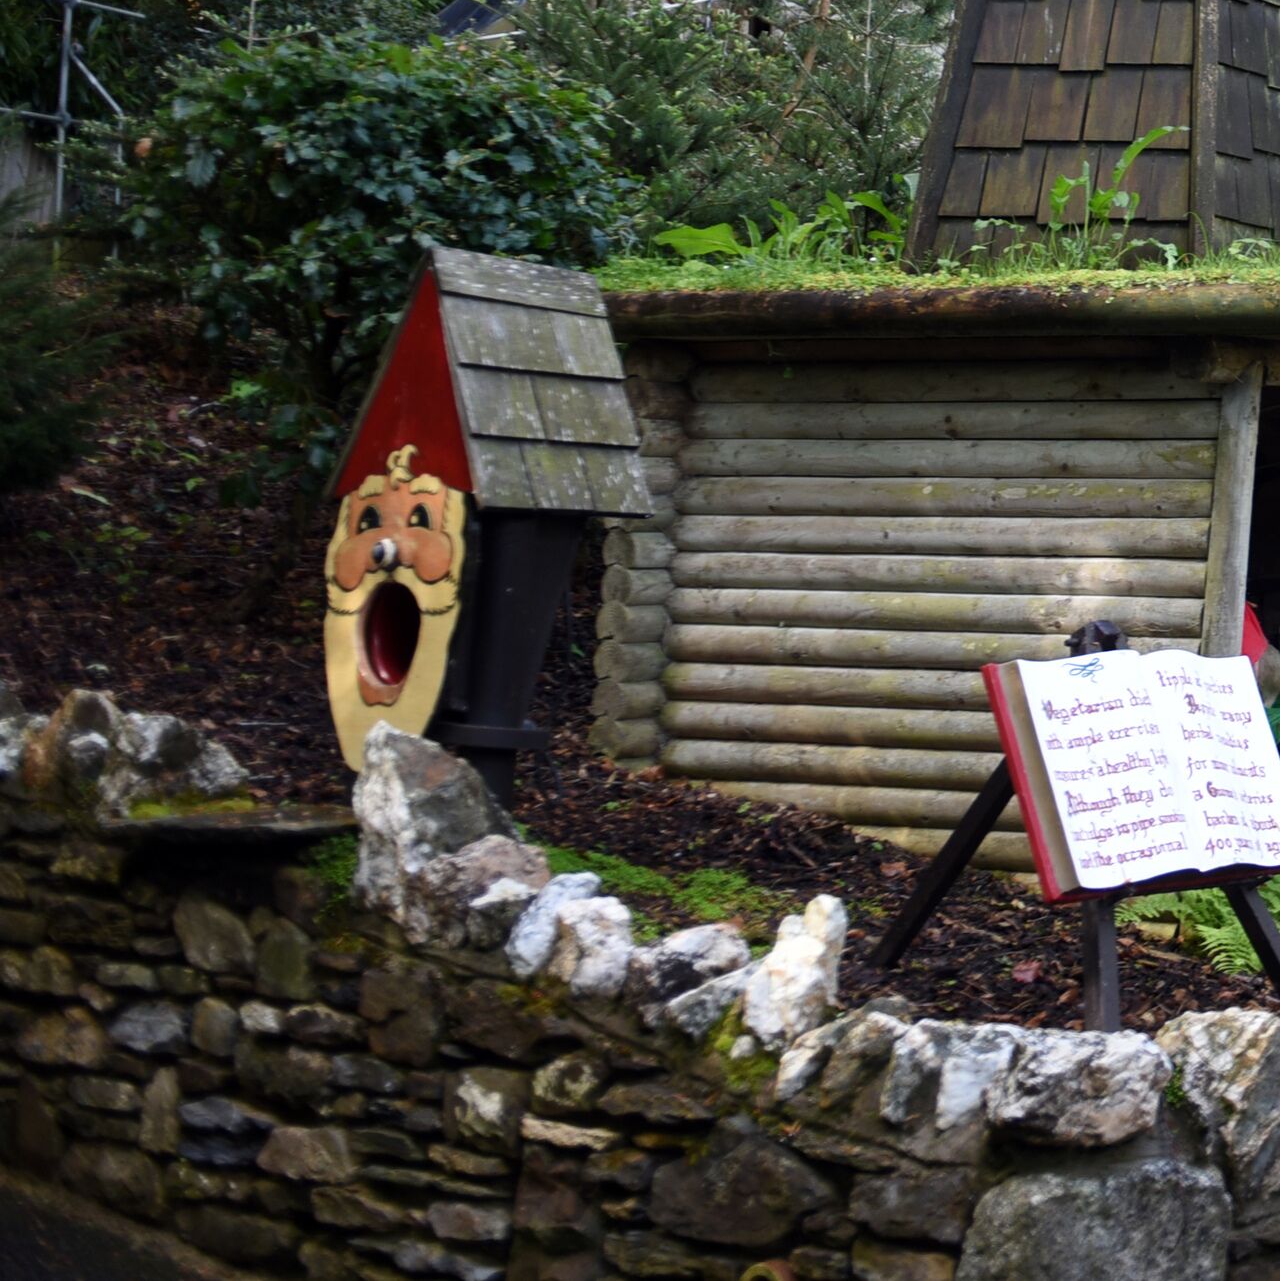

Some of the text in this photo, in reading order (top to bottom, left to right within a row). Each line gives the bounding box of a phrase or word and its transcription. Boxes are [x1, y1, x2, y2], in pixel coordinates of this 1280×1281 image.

[1041, 697, 1124, 725] Vegetarian
[1186, 756, 1207, 780] for
[1064, 788, 1122, 817] Although
[1192, 789, 1204, 802] a
[1116, 831, 1188, 865] occasional
[1205, 838, 1232, 858] 400
